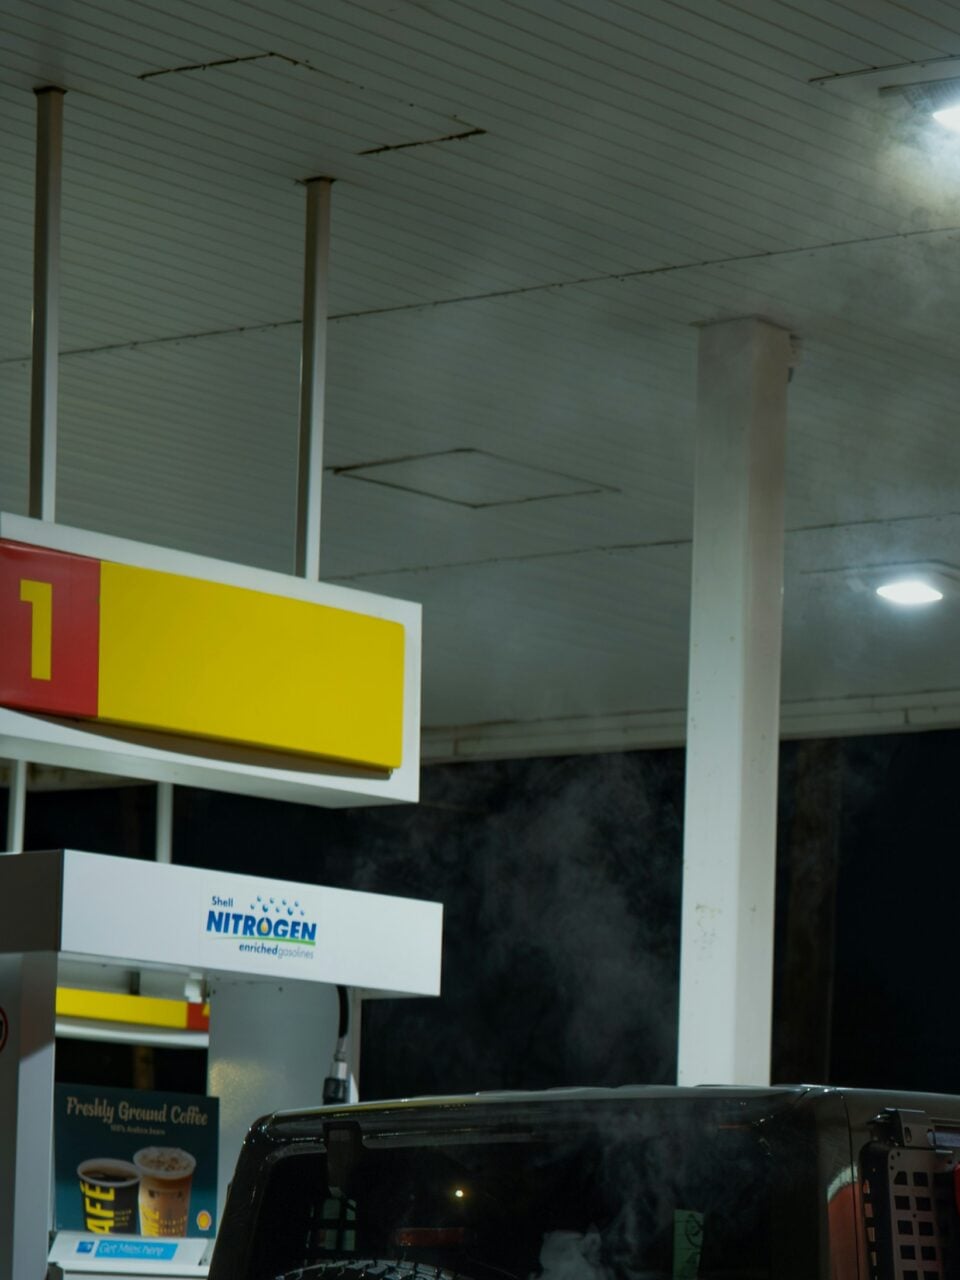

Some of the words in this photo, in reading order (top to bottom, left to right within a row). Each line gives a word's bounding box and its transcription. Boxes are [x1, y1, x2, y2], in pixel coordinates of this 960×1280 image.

[20, 579, 52, 681] 1
[211, 895, 234, 908] Shell
[206, 910, 317, 941] NITROGEN
[118, 1101, 168, 1123] Ground
[170, 1105, 208, 1127] Coffee
